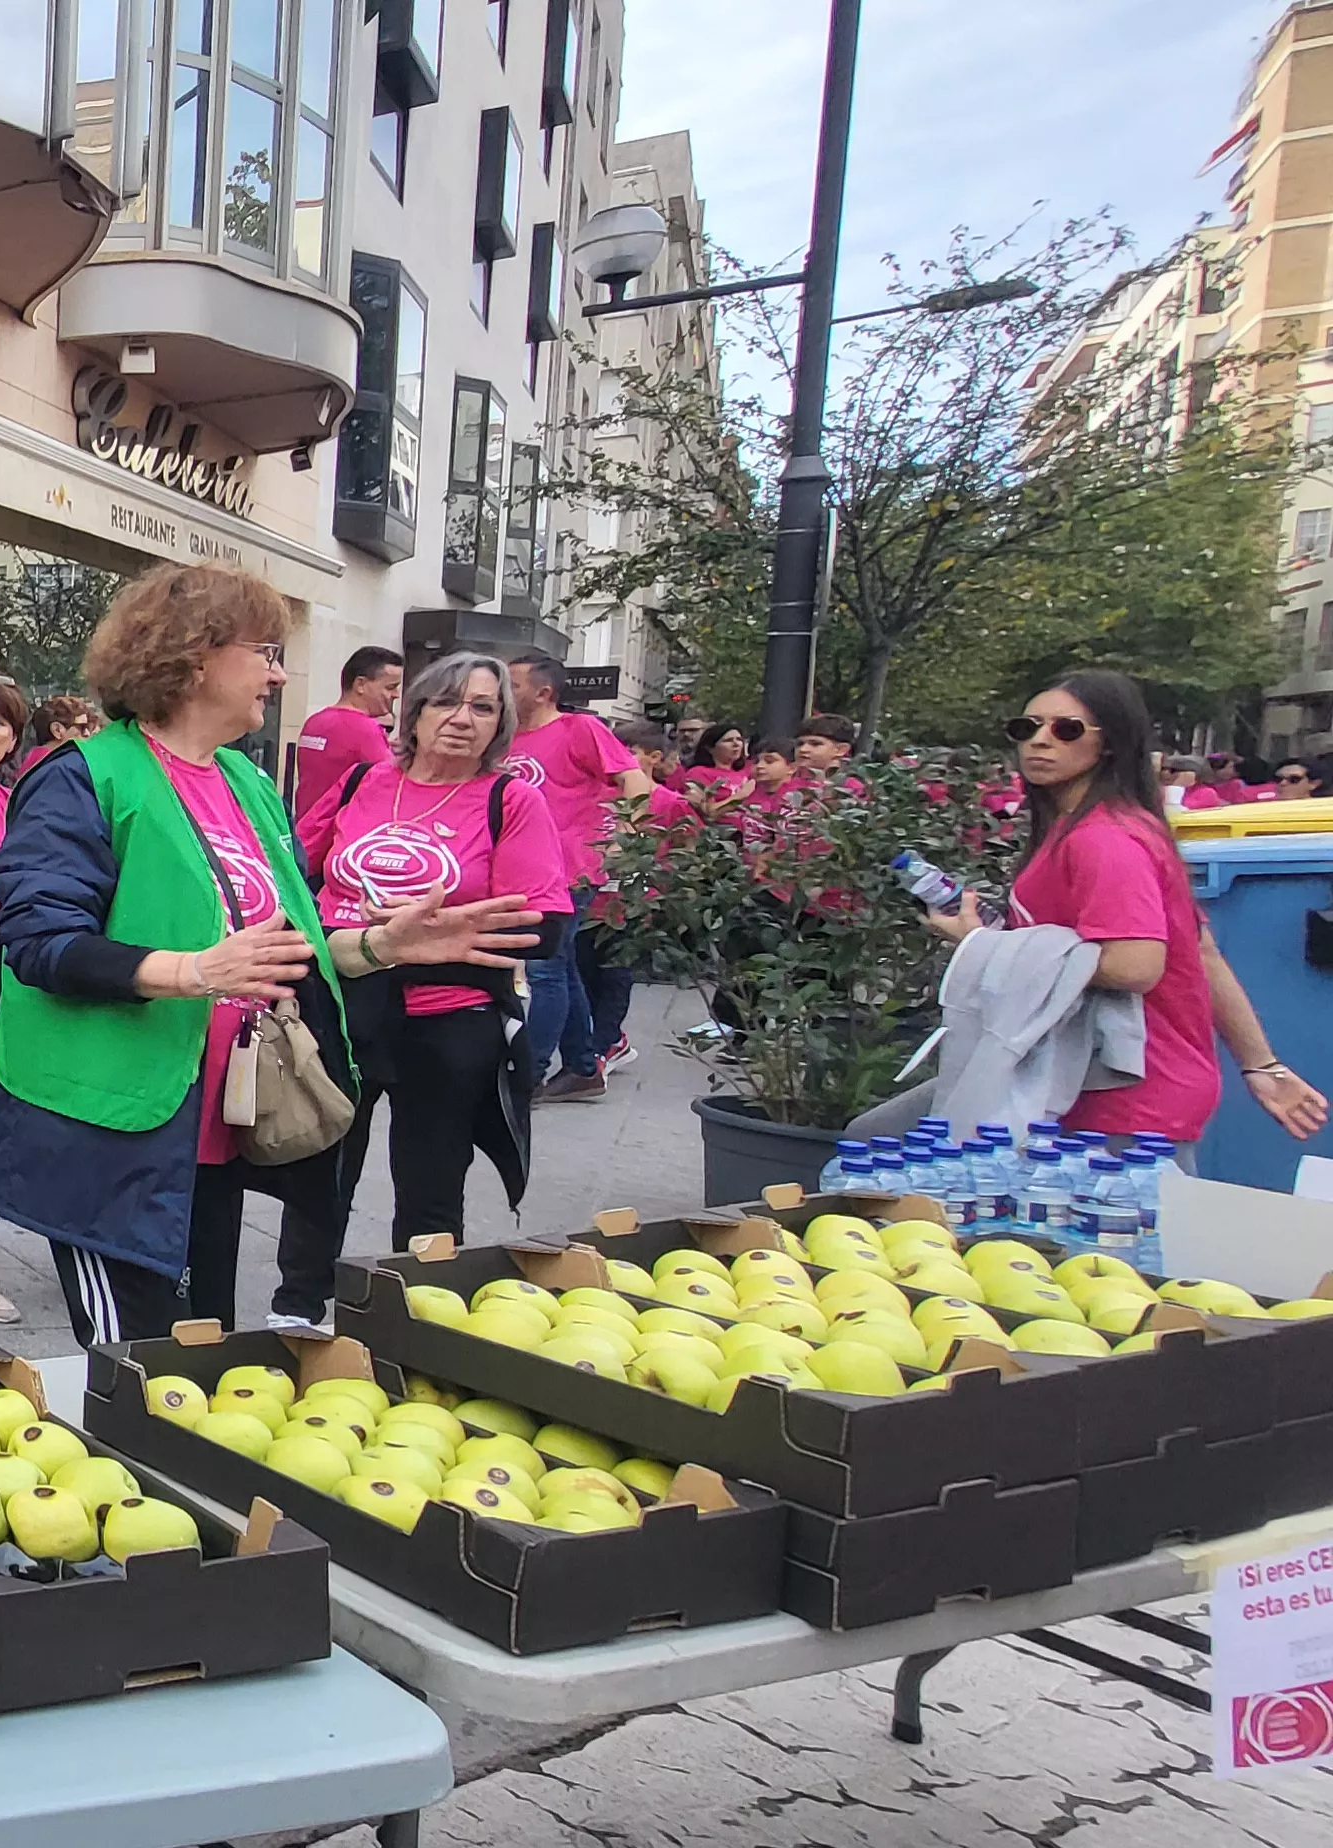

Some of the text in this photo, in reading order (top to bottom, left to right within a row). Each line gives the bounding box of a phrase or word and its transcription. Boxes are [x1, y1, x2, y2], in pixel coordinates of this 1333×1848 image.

[111, 503, 176, 548] RESTAURANTE
[1266, 1559, 1306, 1583] eres
[1307, 1546, 1333, 1573] CE
[1243, 1595, 1286, 1620] esta
[1289, 1591, 1311, 1611] es
